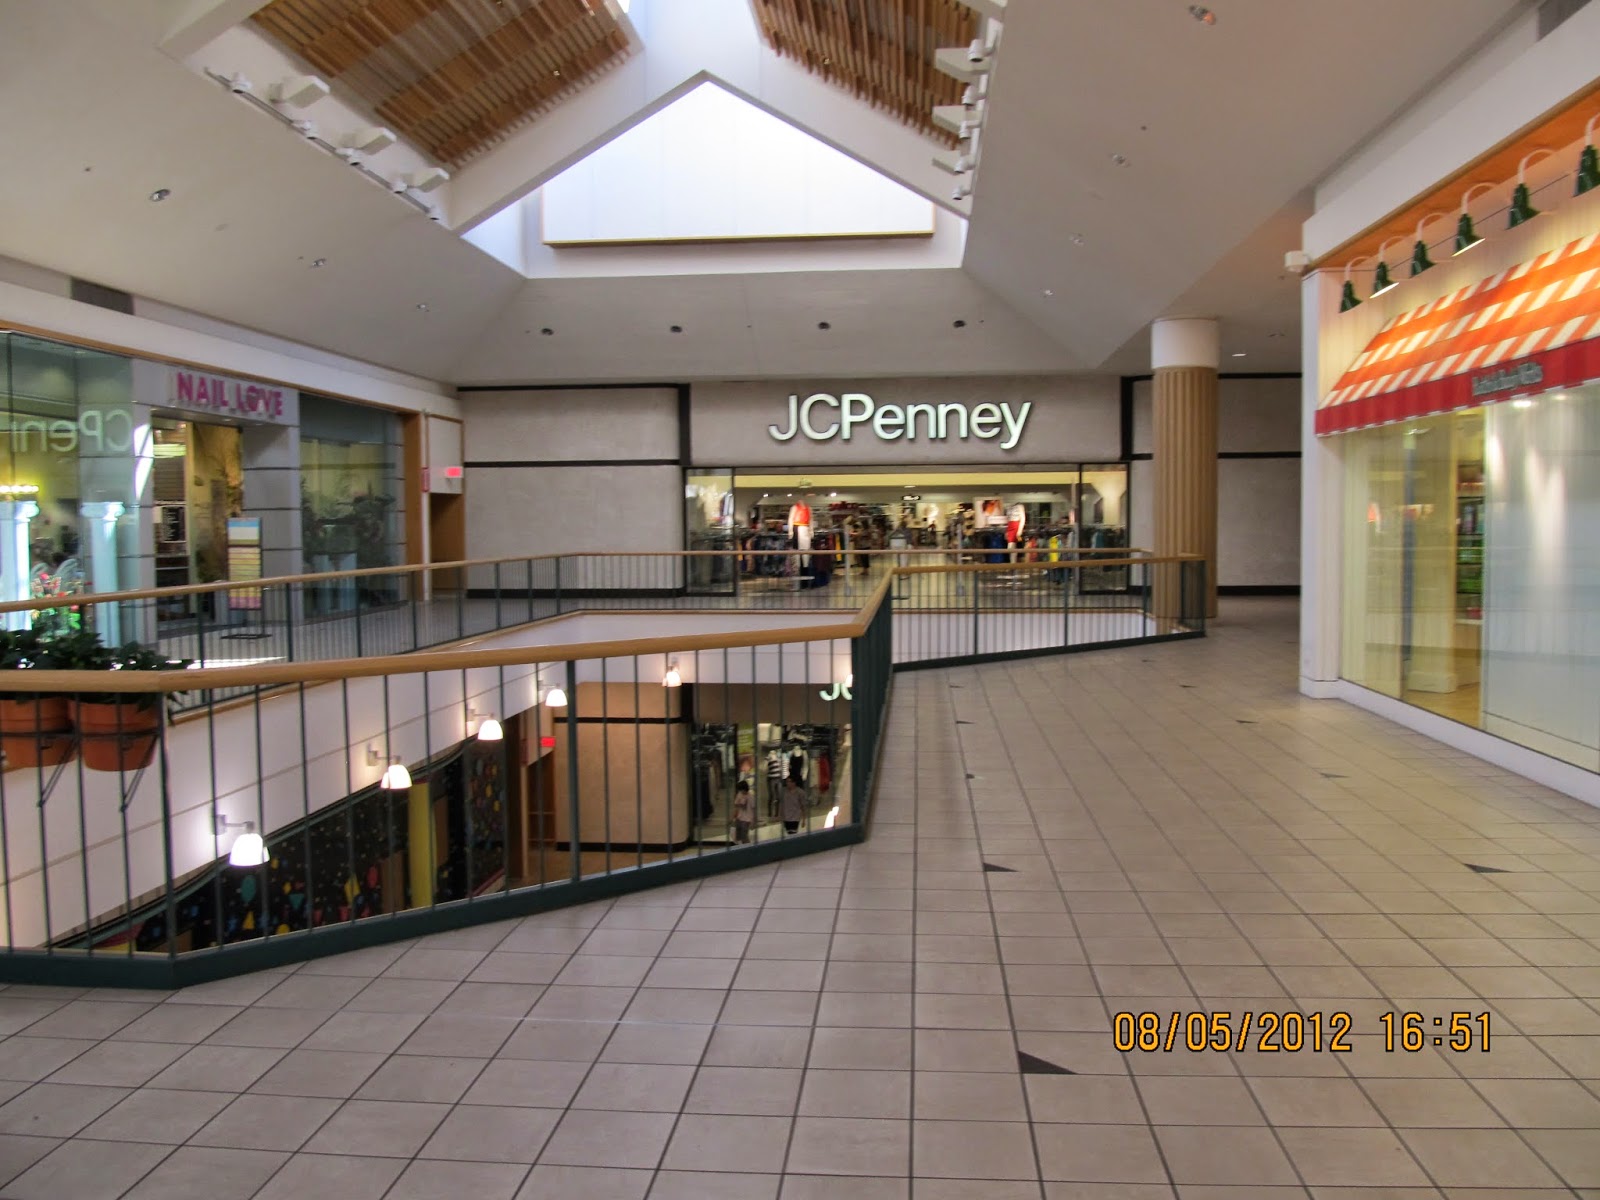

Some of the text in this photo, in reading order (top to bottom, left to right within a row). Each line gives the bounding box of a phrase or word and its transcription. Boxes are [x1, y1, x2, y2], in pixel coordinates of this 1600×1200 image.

[176, 371, 283, 416] NAIL LOVE
[768, 393, 1032, 450] JCPenney
